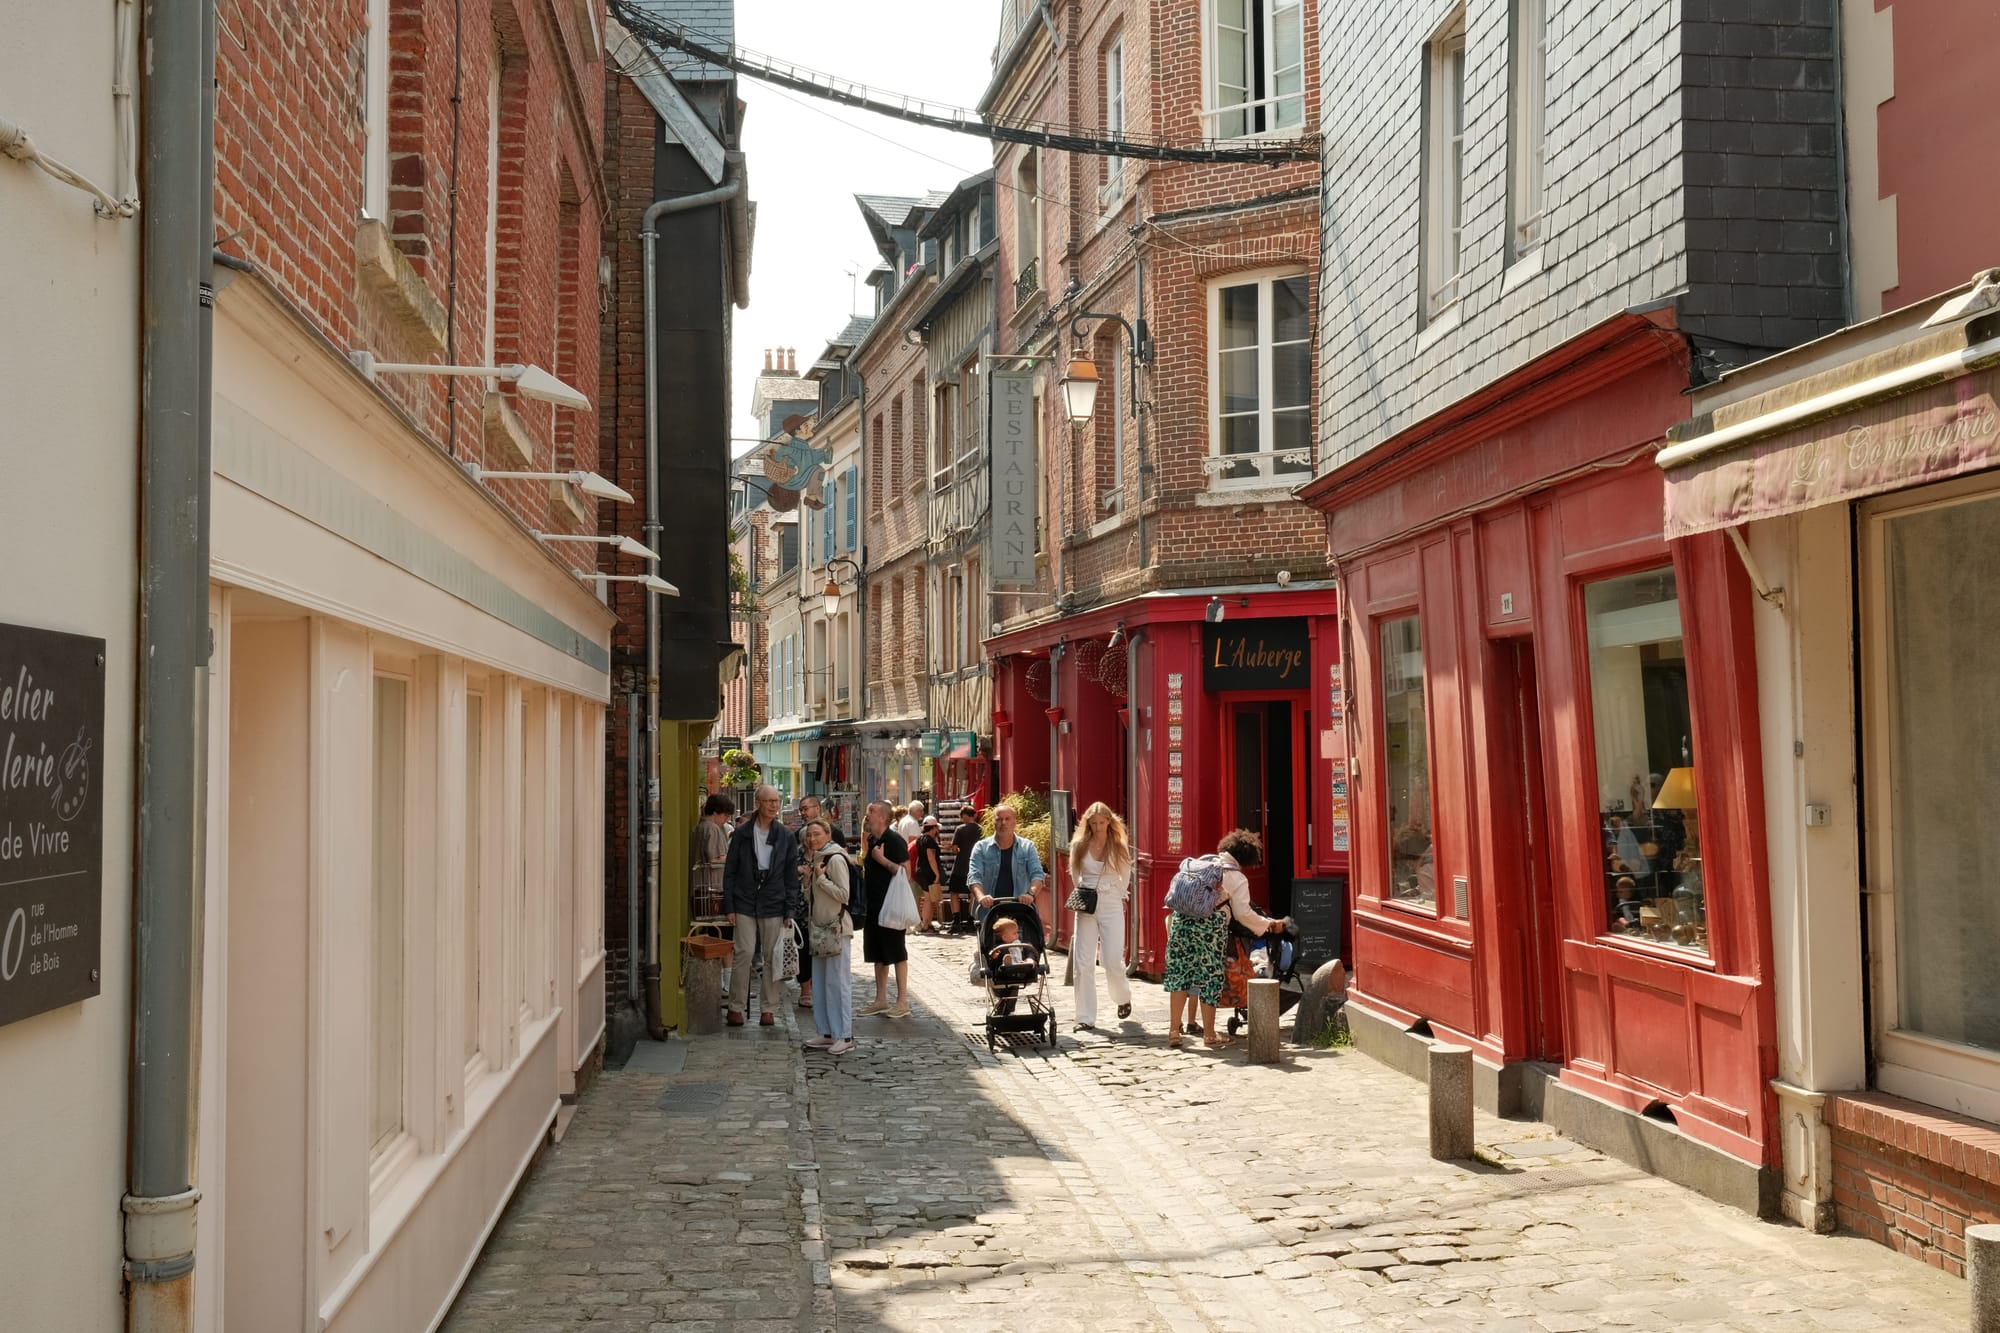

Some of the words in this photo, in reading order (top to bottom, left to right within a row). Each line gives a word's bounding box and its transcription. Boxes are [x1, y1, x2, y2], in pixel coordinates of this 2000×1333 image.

[1843, 409, 1995, 471] Compagnie
[1005, 379, 1024, 576] RESTAURANT
[1214, 637, 1302, 679] L'Auberge
[0, 664, 54, 722] elier
[1, 821, 23, 860] de
[29, 821, 70, 856] Vivre
[31, 903, 45, 917] rue
[30, 926, 42, 946] de
[43, 923, 78, 943] l'Homme
[30, 954, 41, 975] de
[43, 952, 60, 971] Bois
